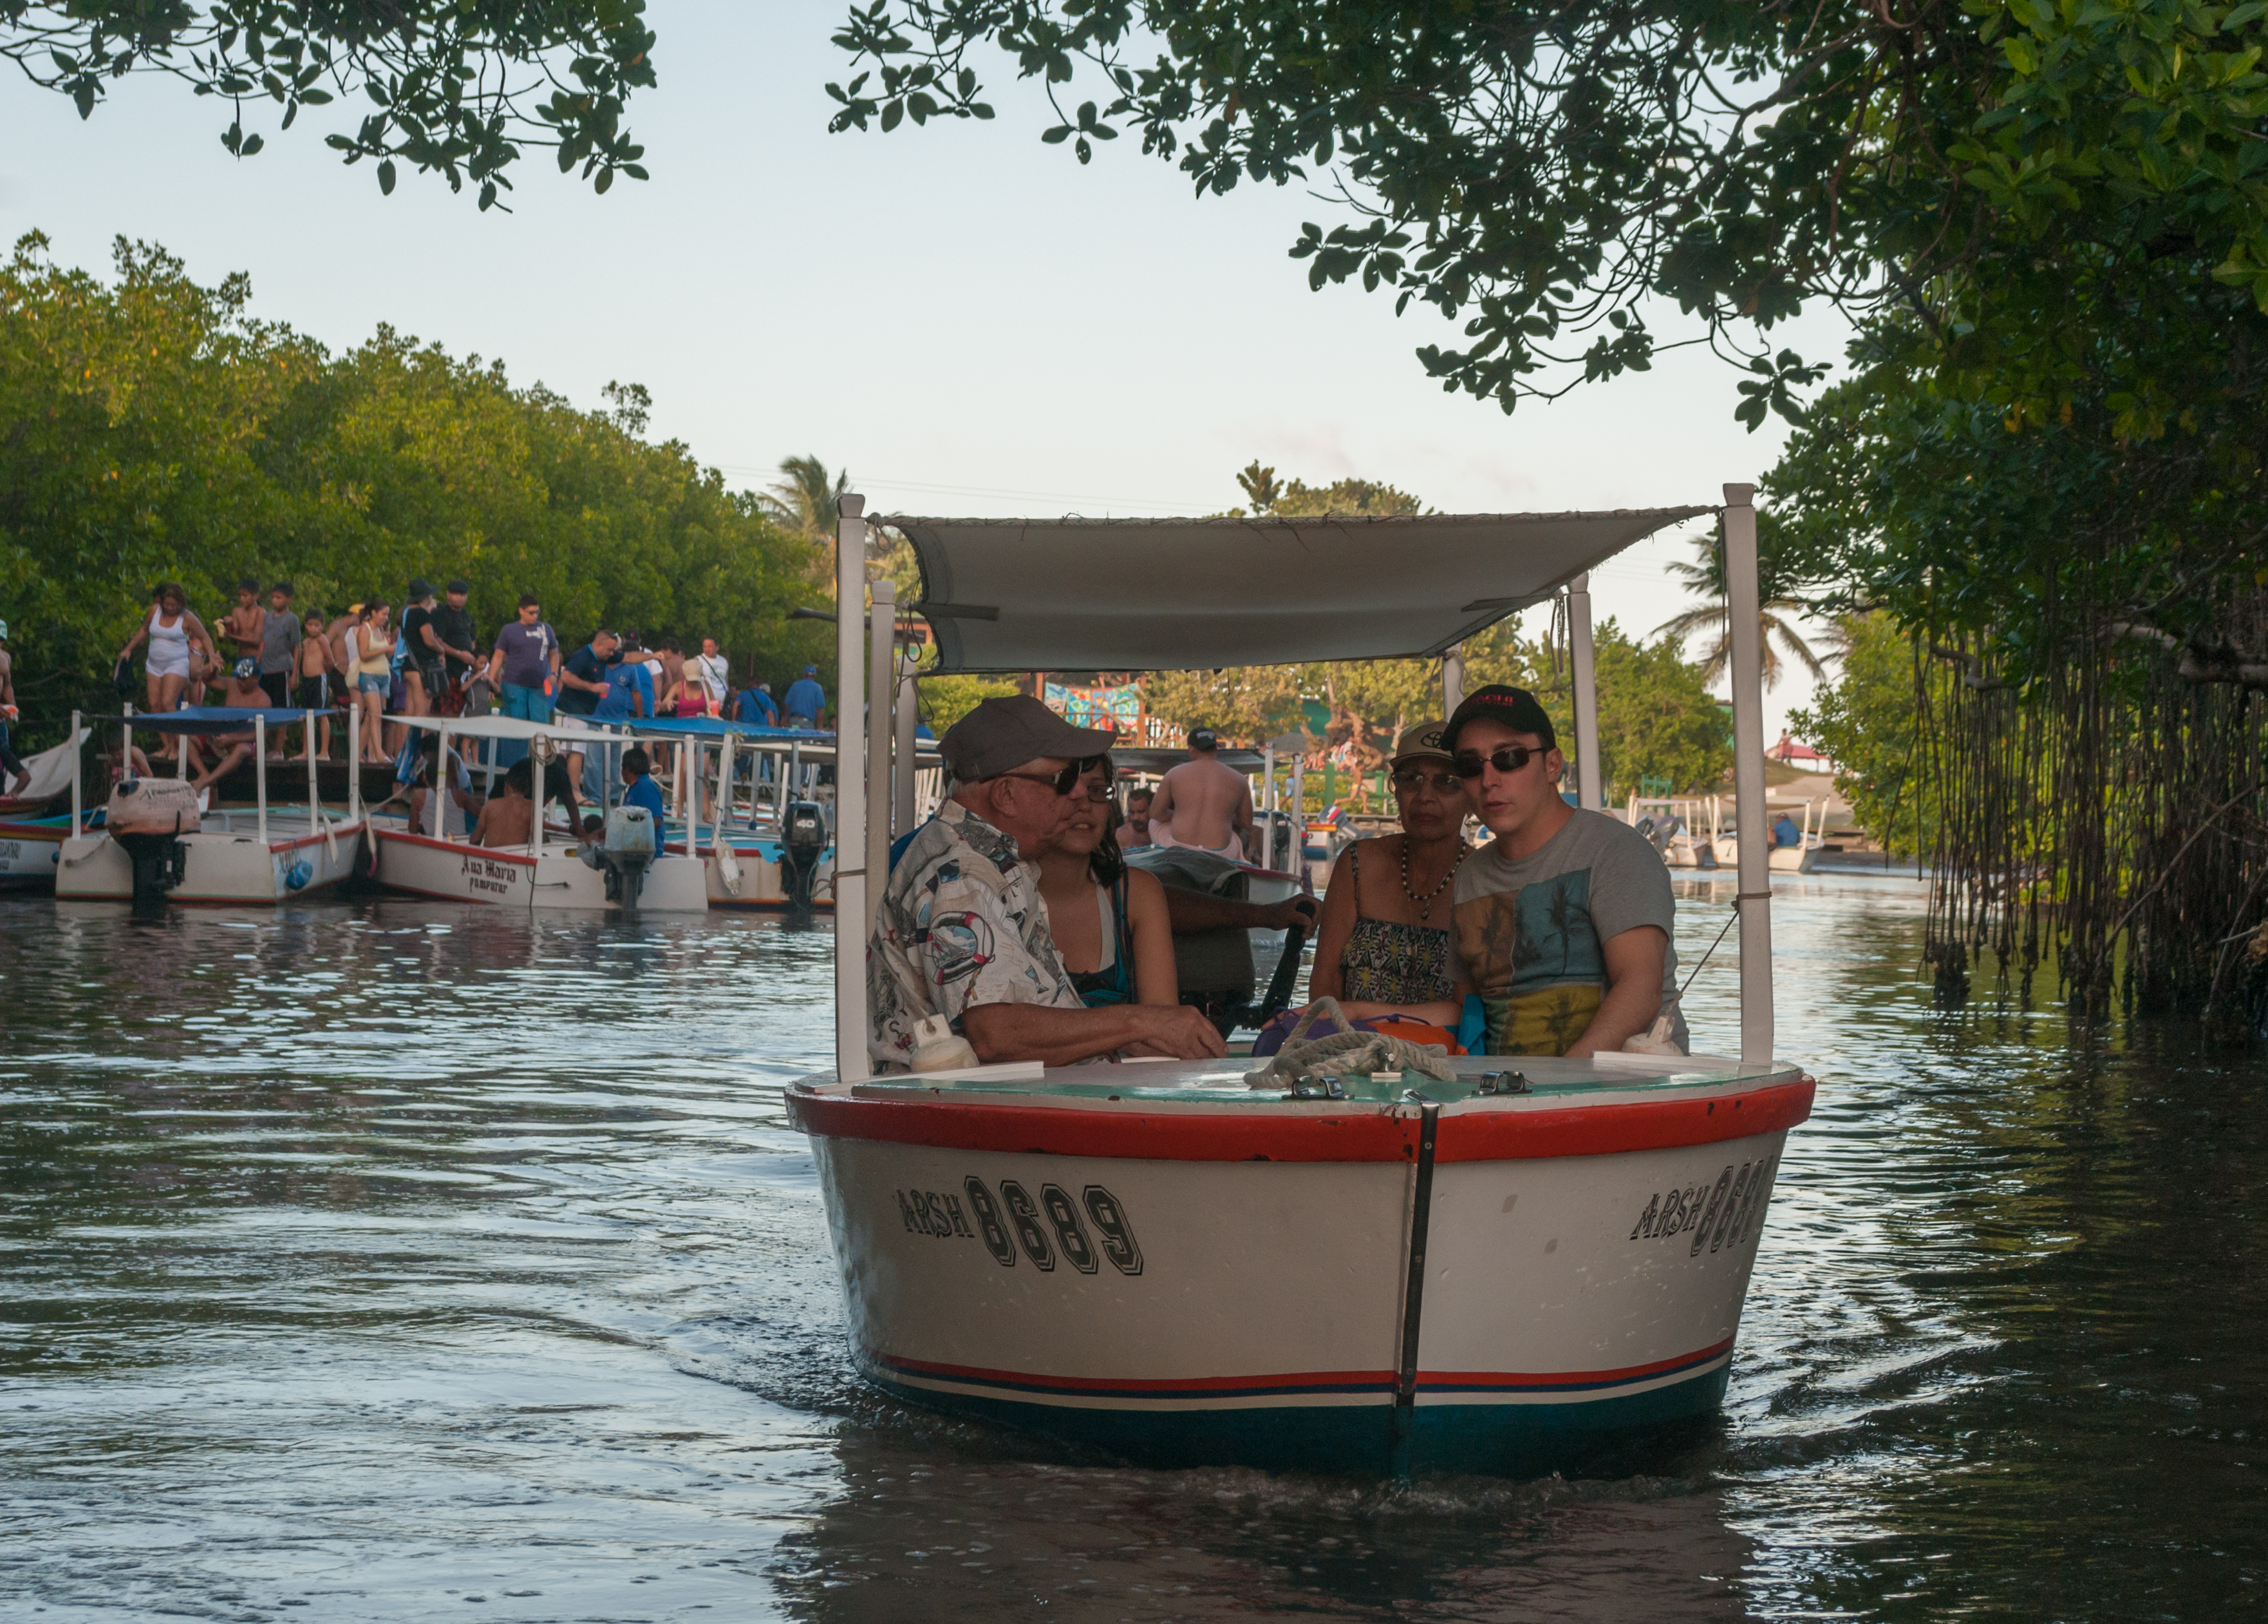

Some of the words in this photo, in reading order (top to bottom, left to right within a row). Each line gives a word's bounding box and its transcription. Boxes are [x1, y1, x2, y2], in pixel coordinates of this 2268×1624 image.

[796, 819, 816, 828] 40
[896, 1189, 975, 1238] ARSH
[964, 1175, 1144, 1276] 8689
[1629, 1185, 1710, 1241] ARSH
